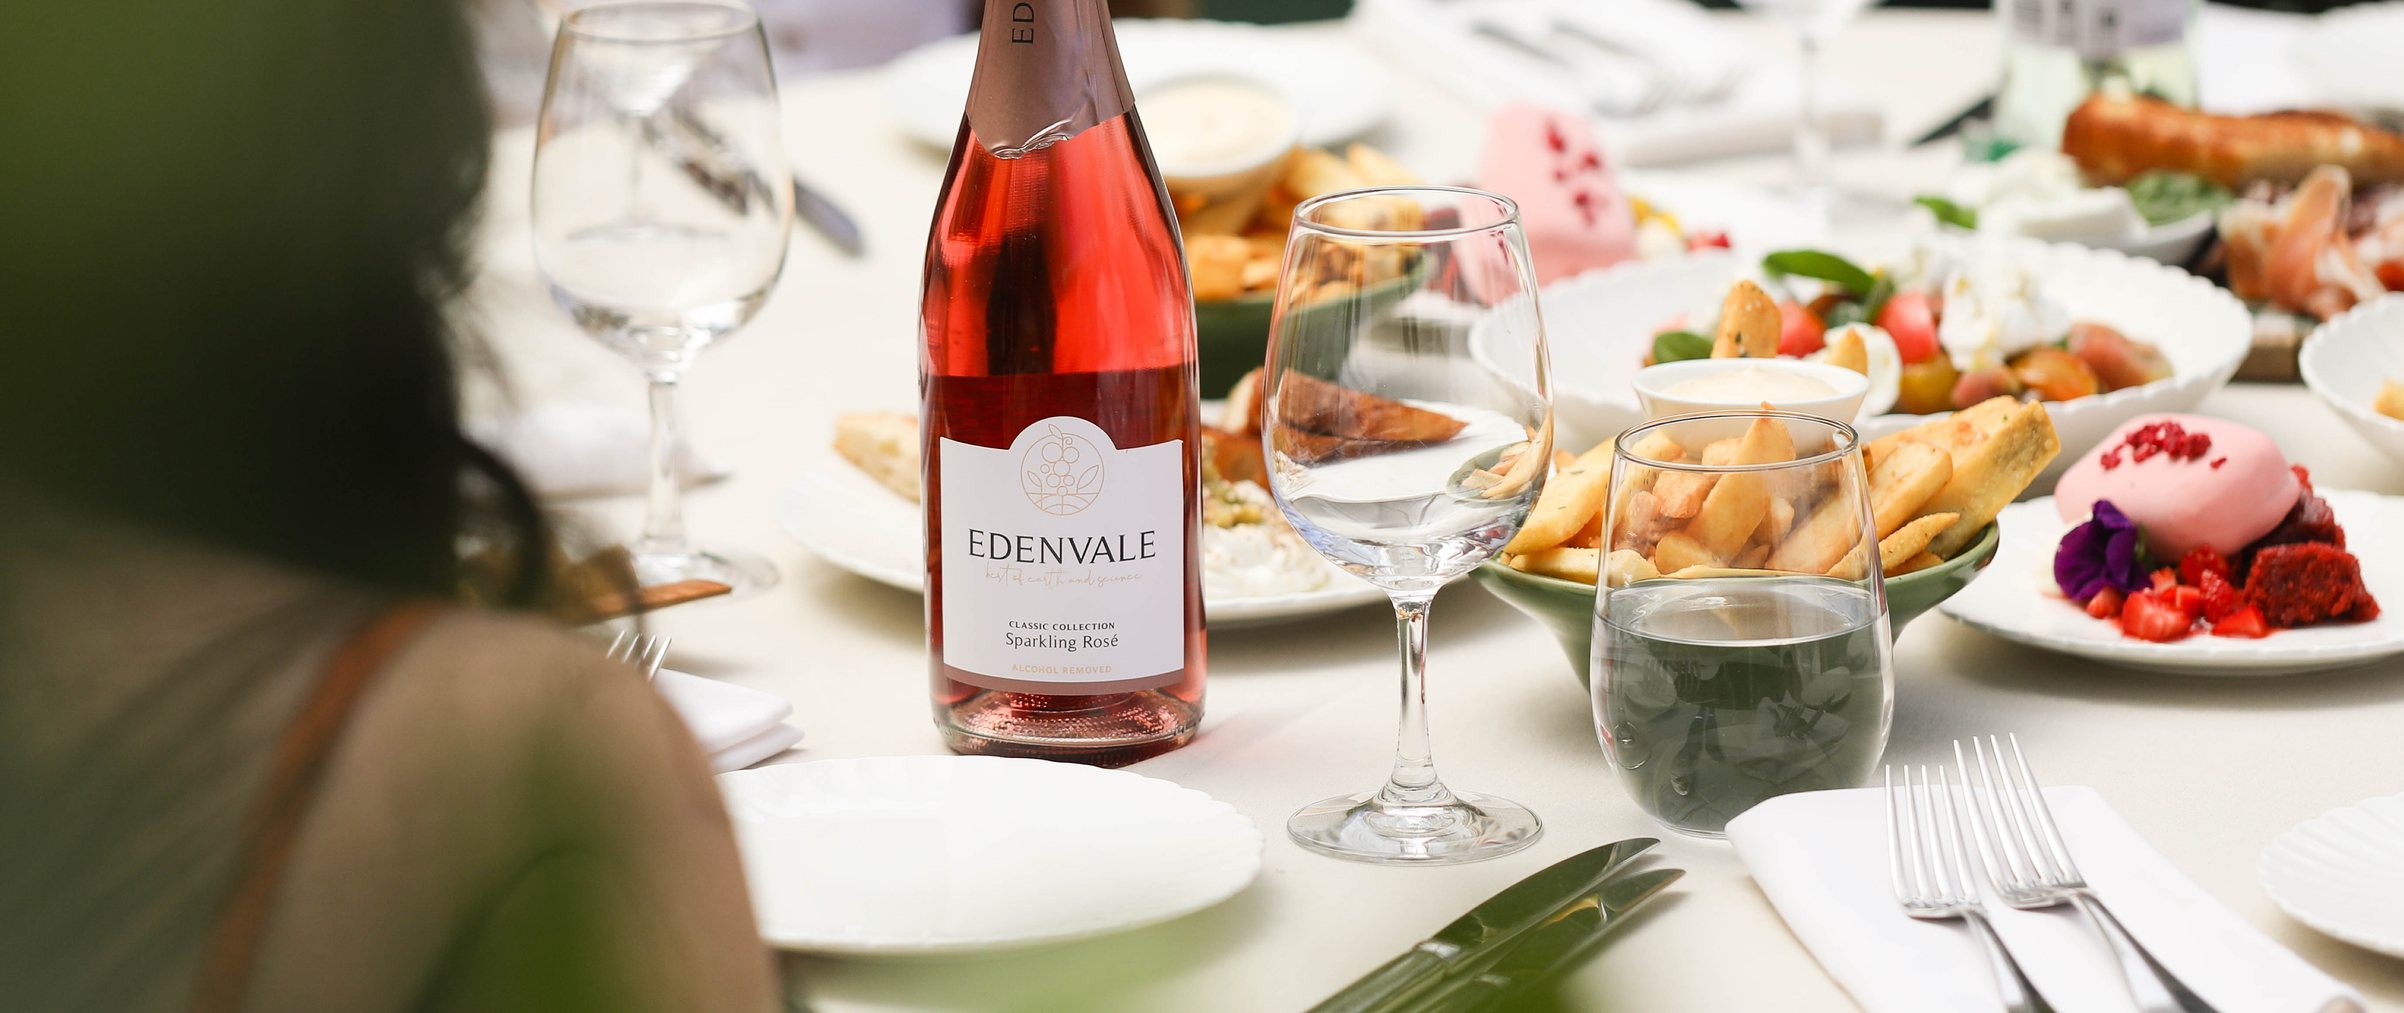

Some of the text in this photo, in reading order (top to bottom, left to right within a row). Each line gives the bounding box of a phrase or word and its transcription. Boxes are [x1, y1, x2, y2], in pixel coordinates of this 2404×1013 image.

[968, 528, 1156, 565] EDENVALE
[1009, 620, 1115, 631] CLASSIC COLLECTION
[1006, 632, 1119, 652] Sparkling Rosé
[1012, 664, 1112, 674] ALCOHOL REMOVED
